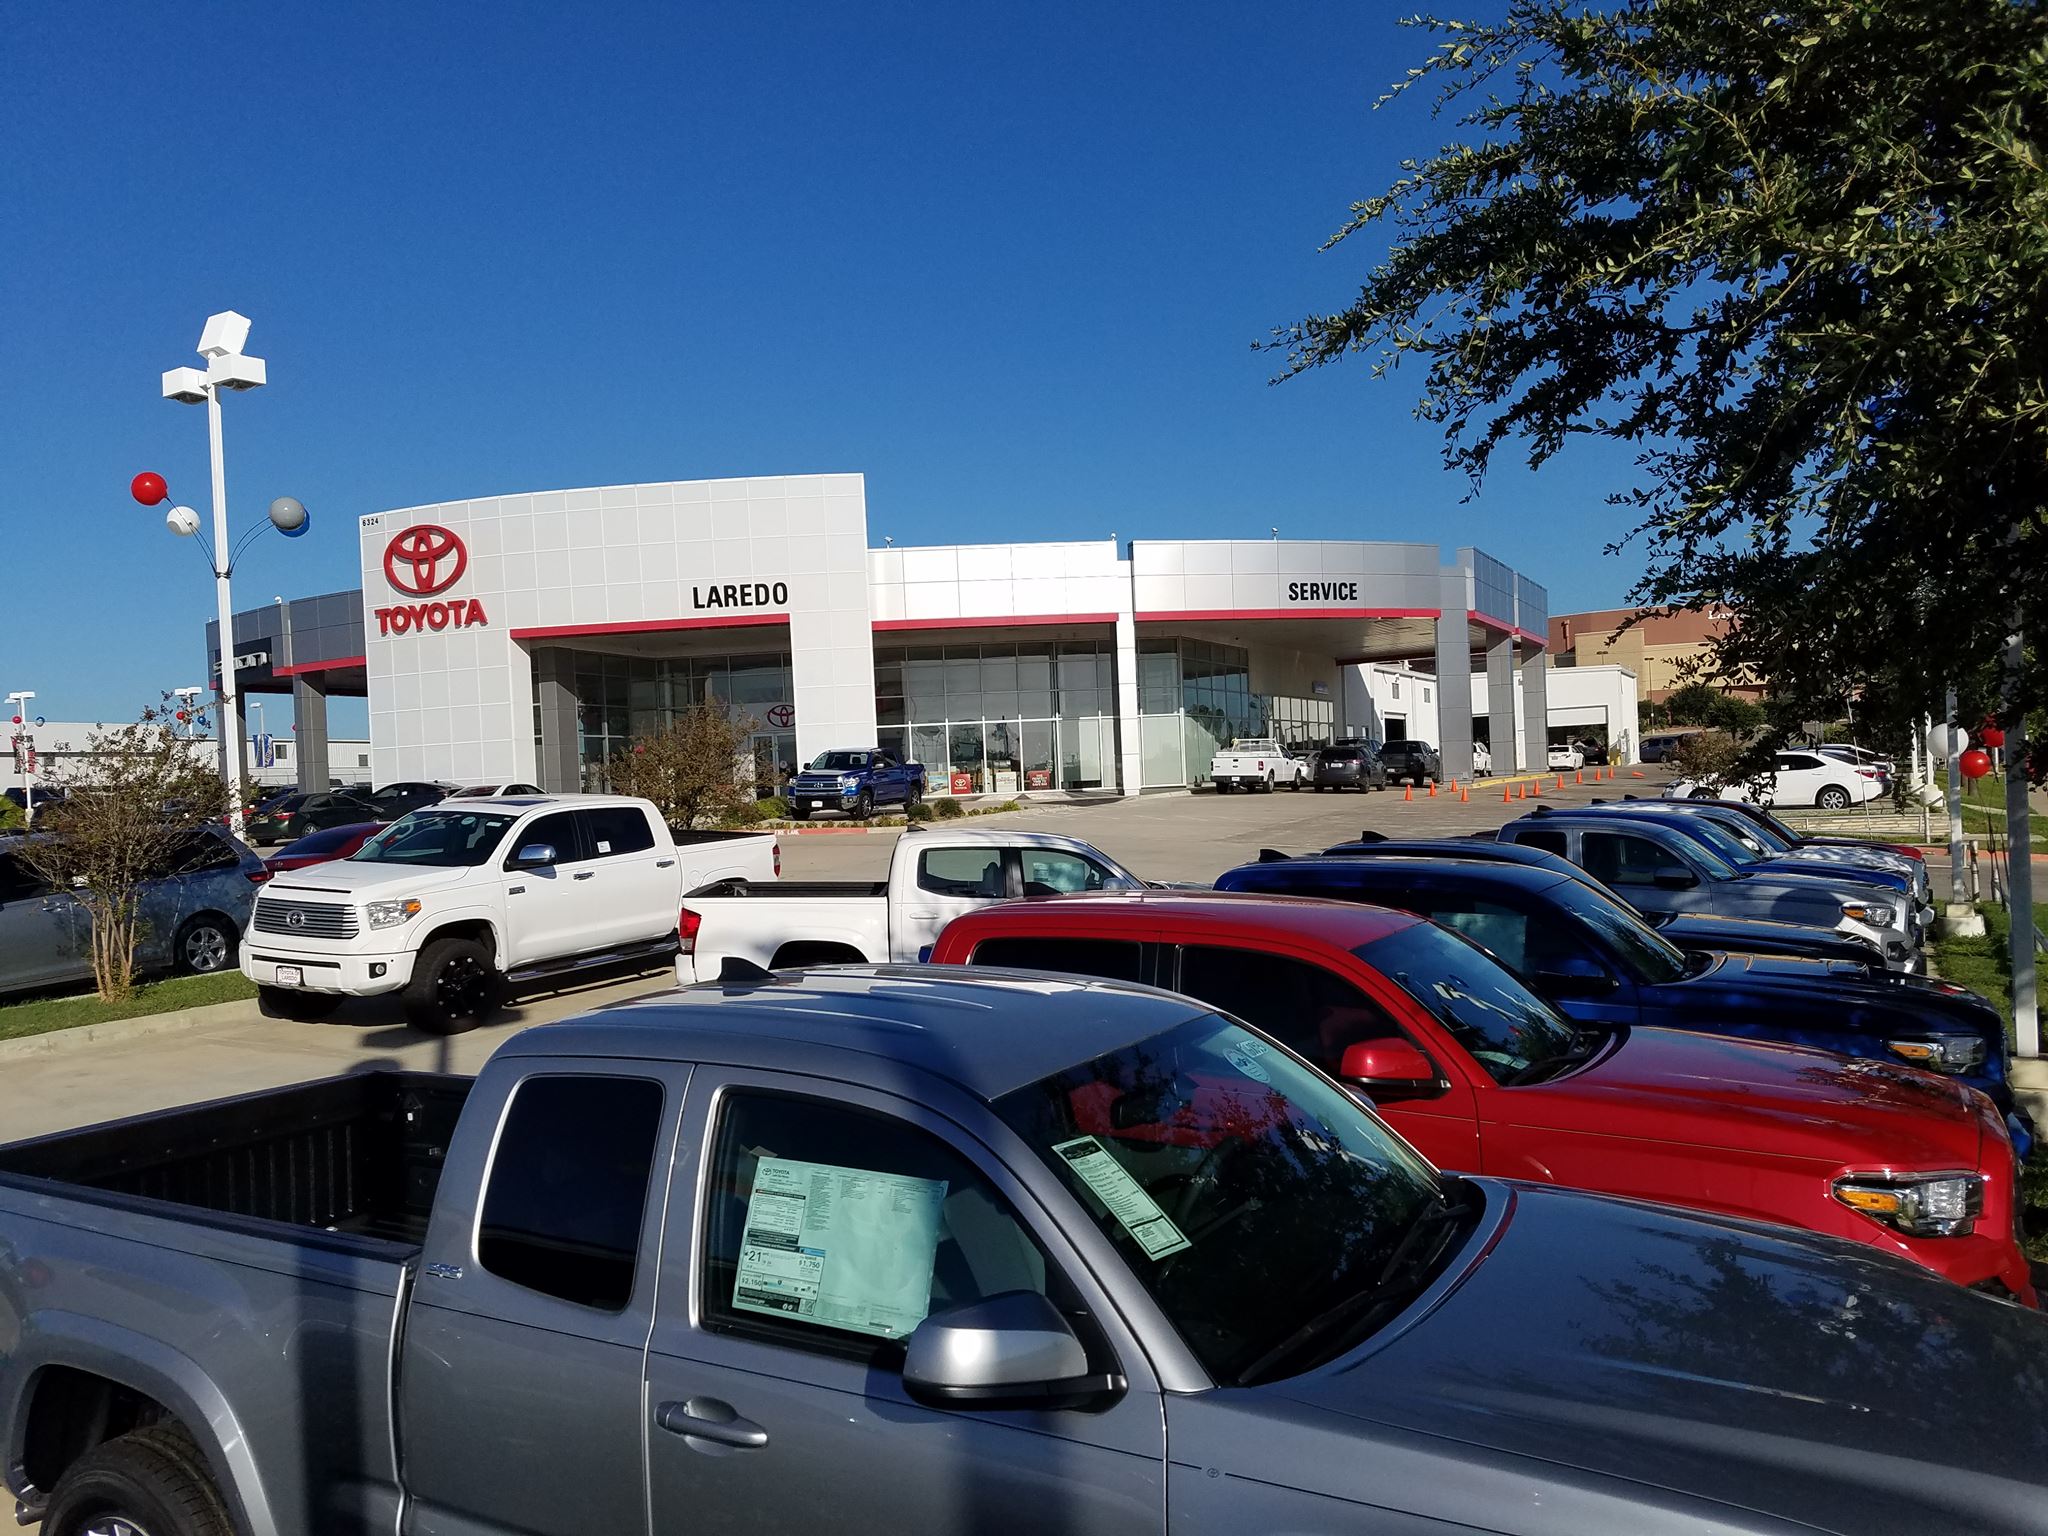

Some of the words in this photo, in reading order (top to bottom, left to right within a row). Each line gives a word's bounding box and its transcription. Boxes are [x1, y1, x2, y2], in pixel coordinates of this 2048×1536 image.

[362, 517, 379, 527] 6324
[692, 582, 788, 609] LAREDO
[1288, 582, 1358, 601] SERVICE
[375, 599, 488, 637] TOYOTA
[772, 1168, 790, 1176] TOYOTA
[748, 1250, 761, 1262] 21
[799, 1260, 820, 1269] $1,750
